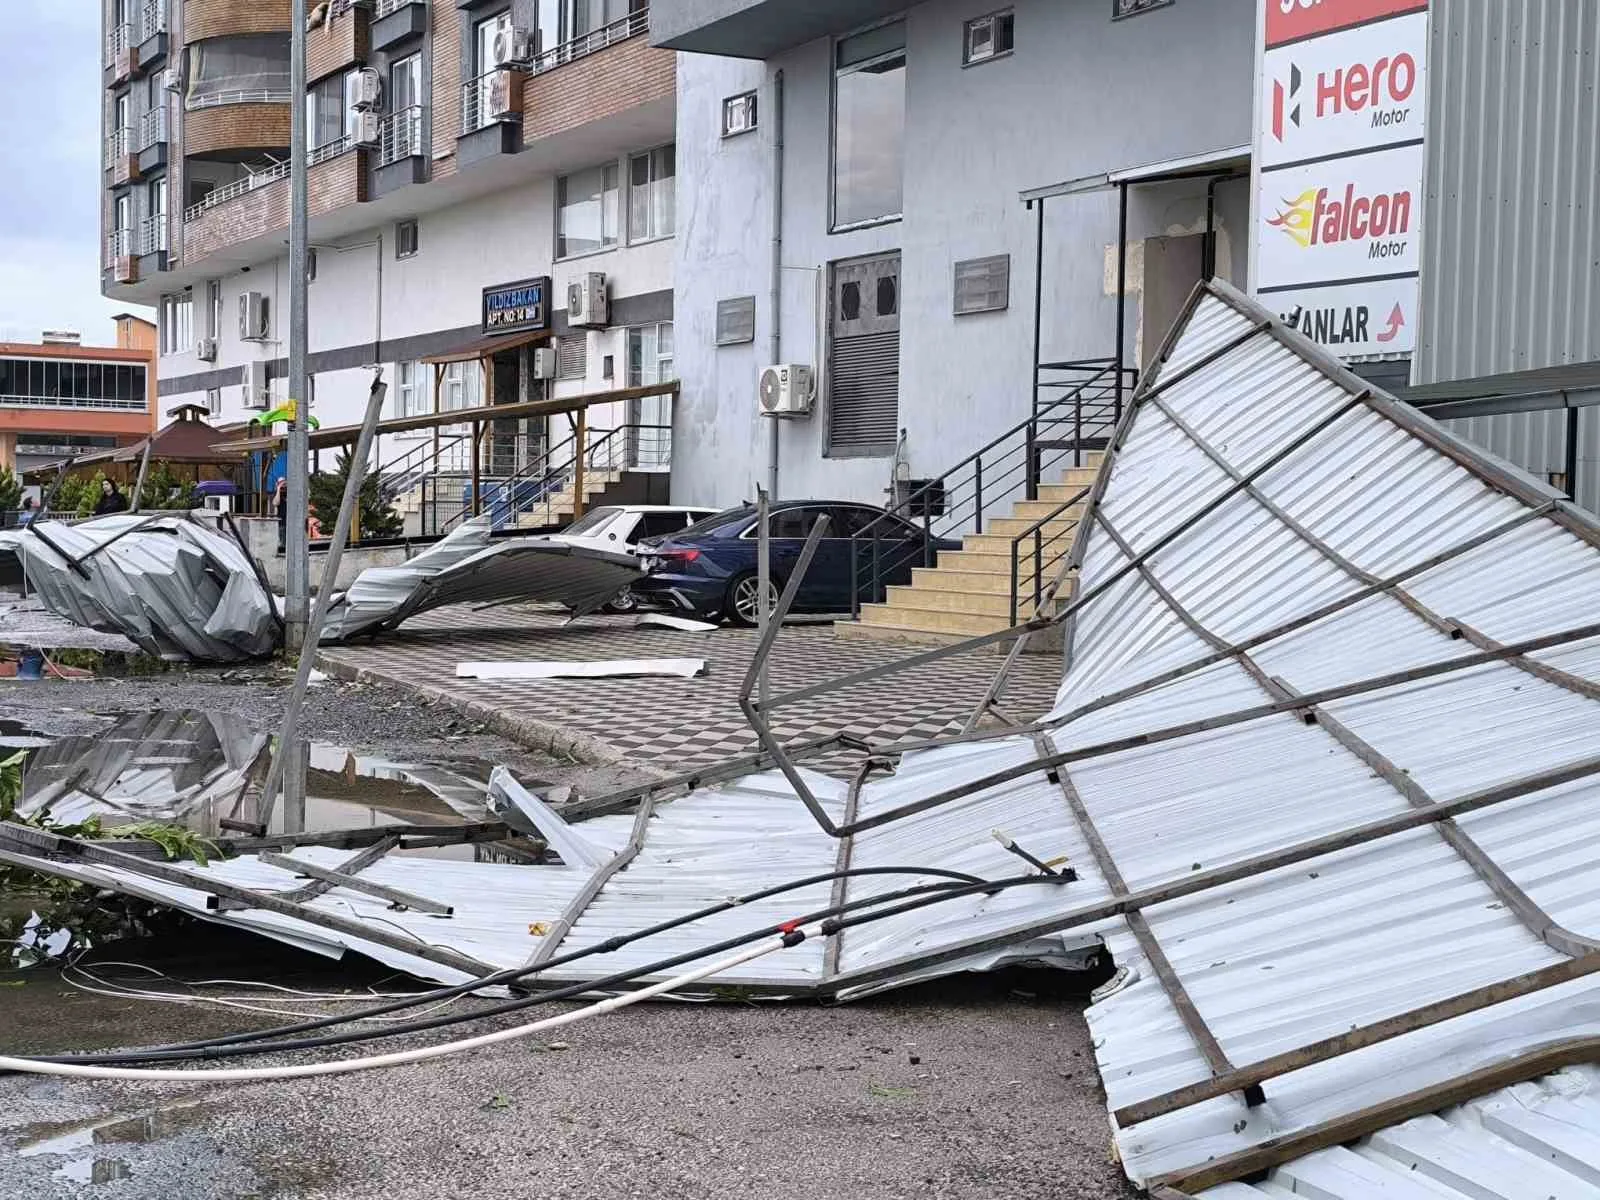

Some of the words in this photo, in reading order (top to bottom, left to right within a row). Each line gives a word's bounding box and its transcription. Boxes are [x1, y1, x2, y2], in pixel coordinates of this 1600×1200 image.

[1316, 52, 1416, 118] Hero
[1371, 108, 1410, 129] Motor
[1311, 183, 1411, 245] falcon
[1368, 240, 1408, 260] Motor
